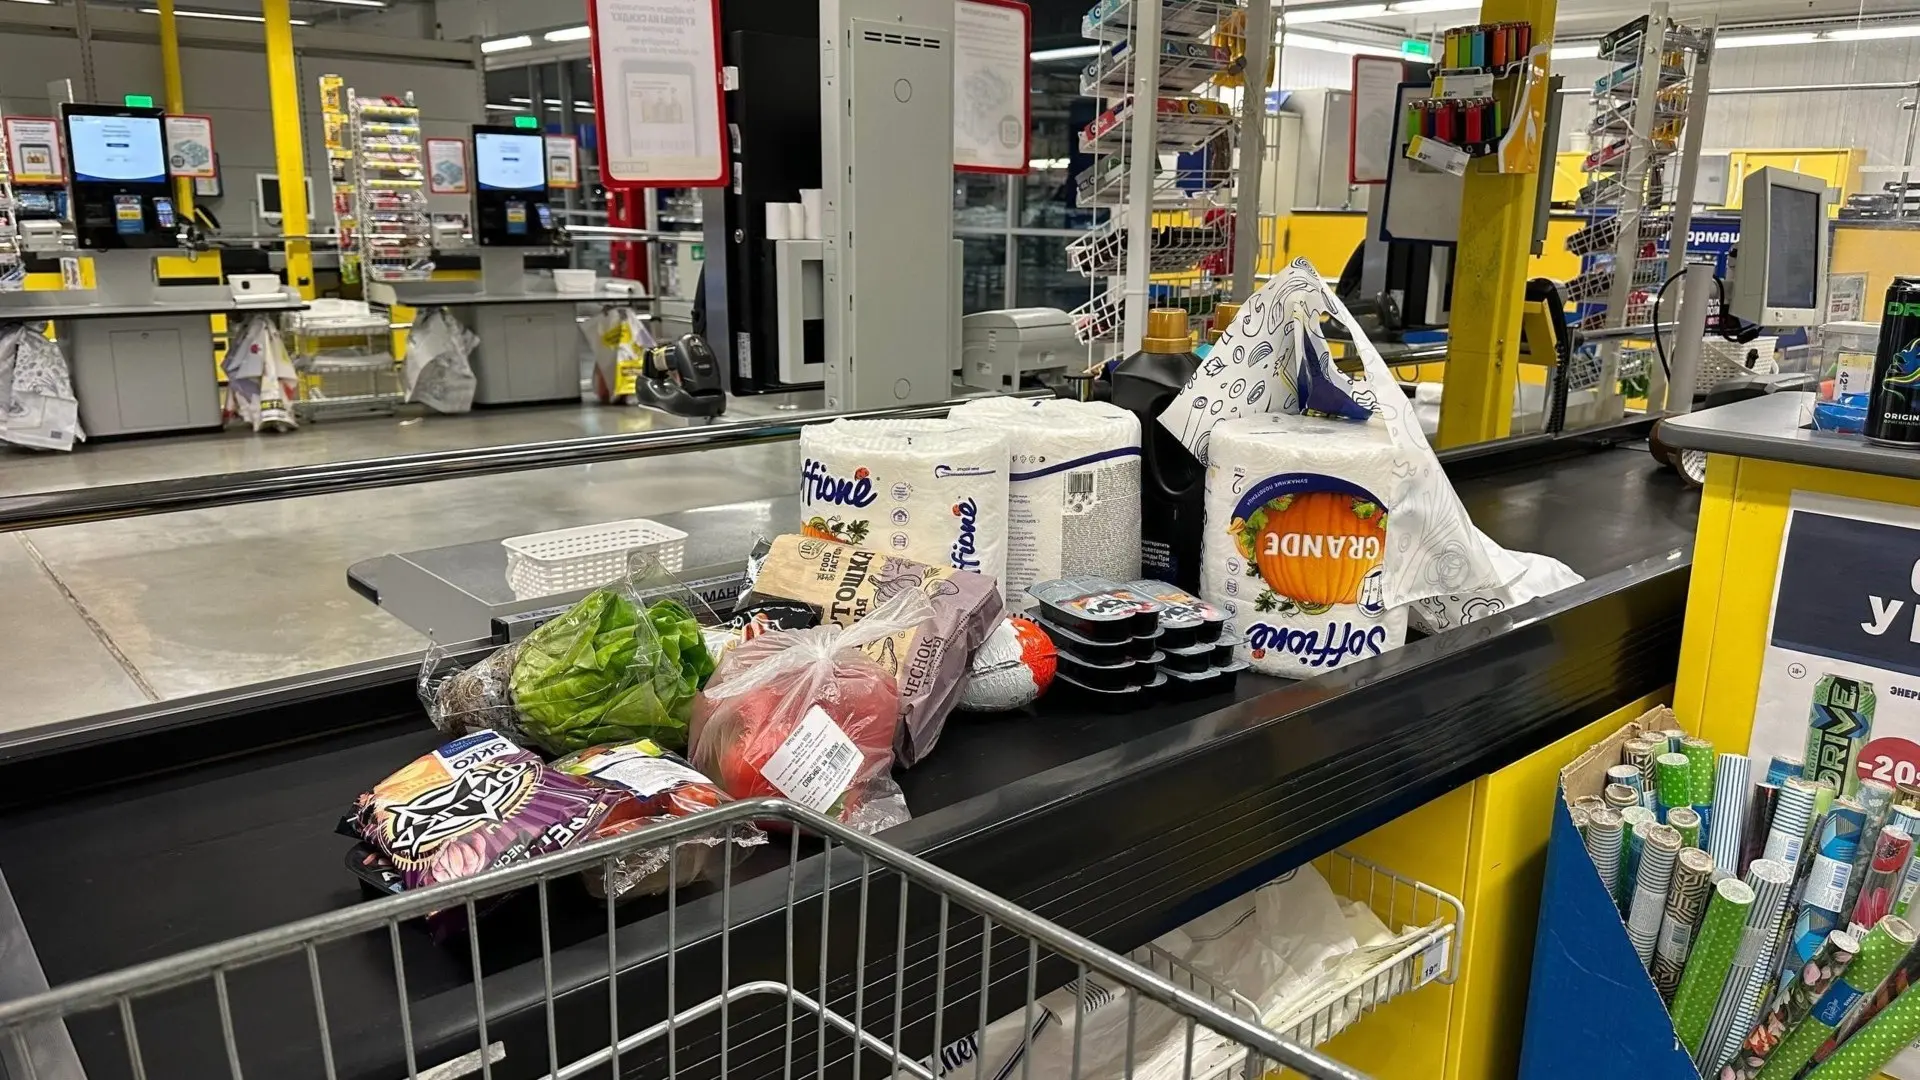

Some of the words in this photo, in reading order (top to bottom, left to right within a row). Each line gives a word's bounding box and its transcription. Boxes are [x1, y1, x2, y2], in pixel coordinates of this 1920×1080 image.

[1887, 301, 1920, 317] DR
[1884, 412, 1920, 421] ORIGIN
[800, 458, 878, 508] ffione
[1232, 473, 1244, 495] 2
[1263, 532, 1379, 559] GRANDE
[820, 552, 832, 572] FOOD
[831, 550, 876, 630] ТОШКА
[1244, 622, 1386, 667] Soffione
[902, 636, 935, 696] ЧЕСНОК
[1890, 686, 1920, 701] ЭНЕР
[1807, 736, 1820, 781] RIGINAL
[800, 764, 822, 788] СПАСИБО
[492, 845, 526, 870] ЧЕСН
